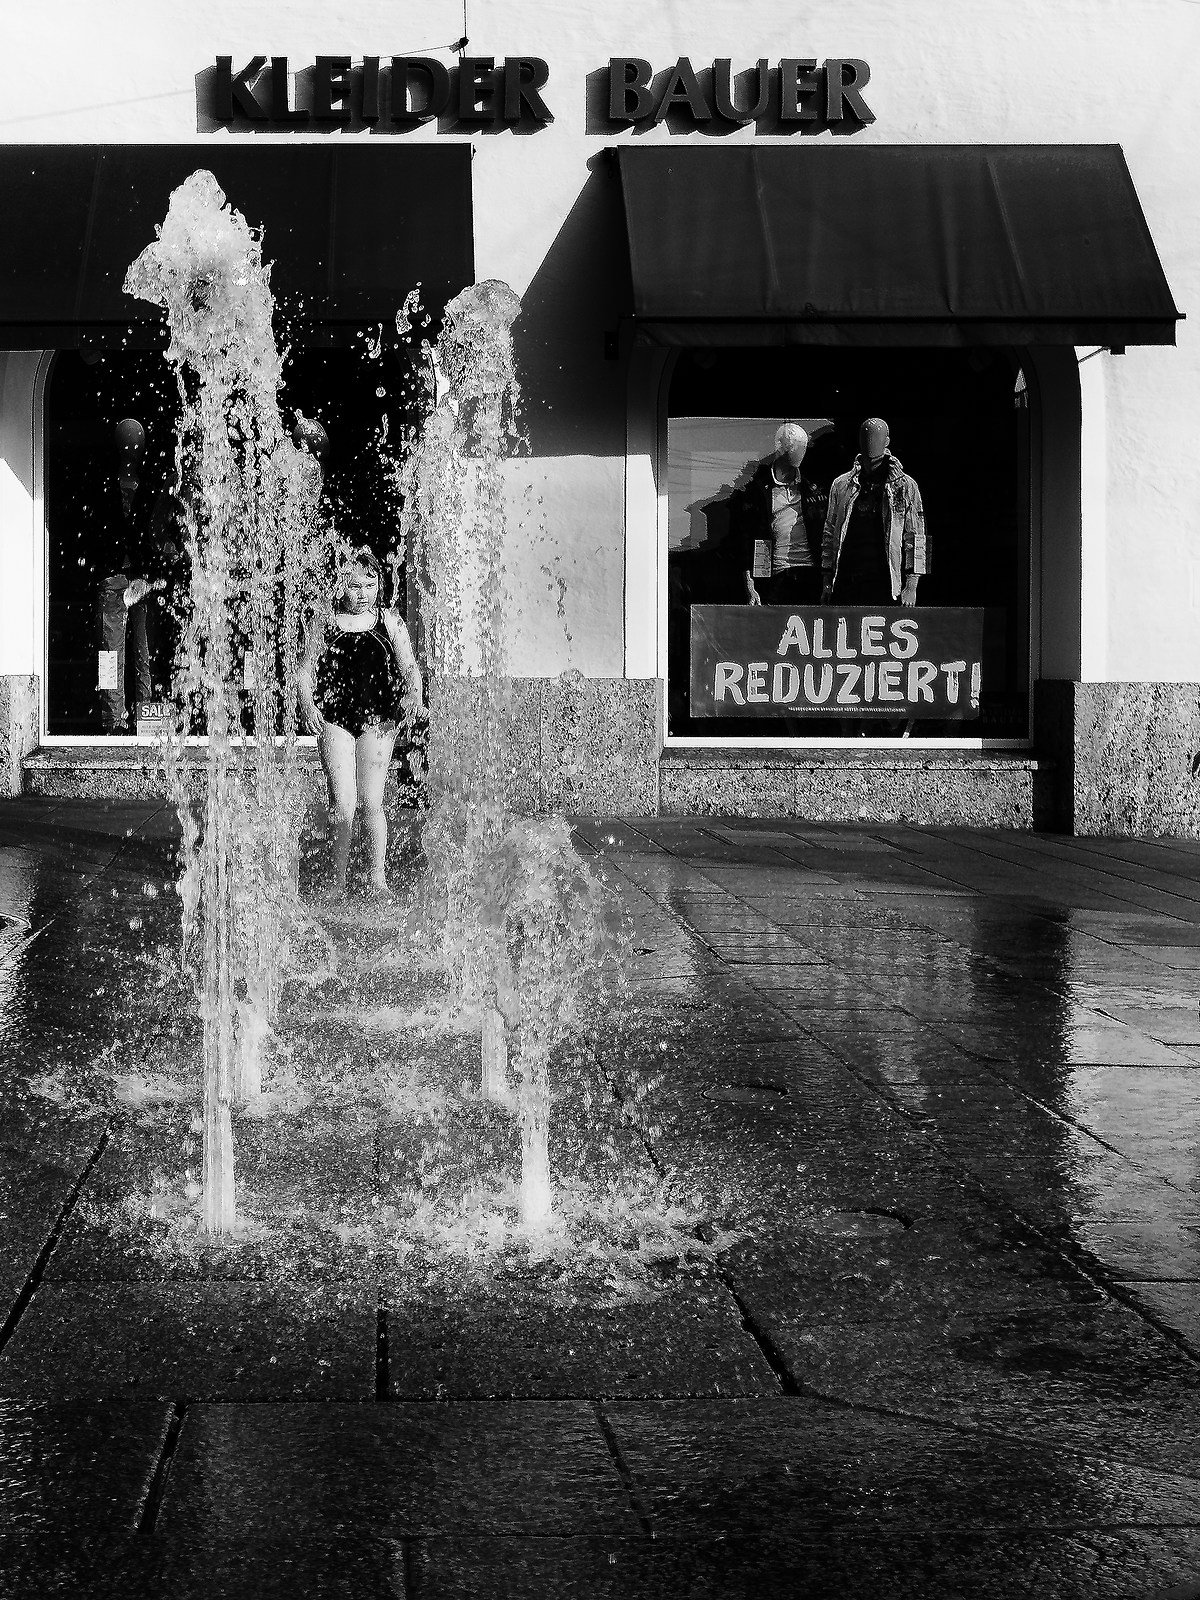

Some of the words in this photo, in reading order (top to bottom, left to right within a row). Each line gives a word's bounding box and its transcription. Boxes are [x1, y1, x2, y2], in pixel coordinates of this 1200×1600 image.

[213, 55, 554, 123] KLEIDER
[607, 56, 876, 123] BAUER
[776, 614, 919, 659] ALLES
[713, 661, 981, 709] REDUZIERT!
